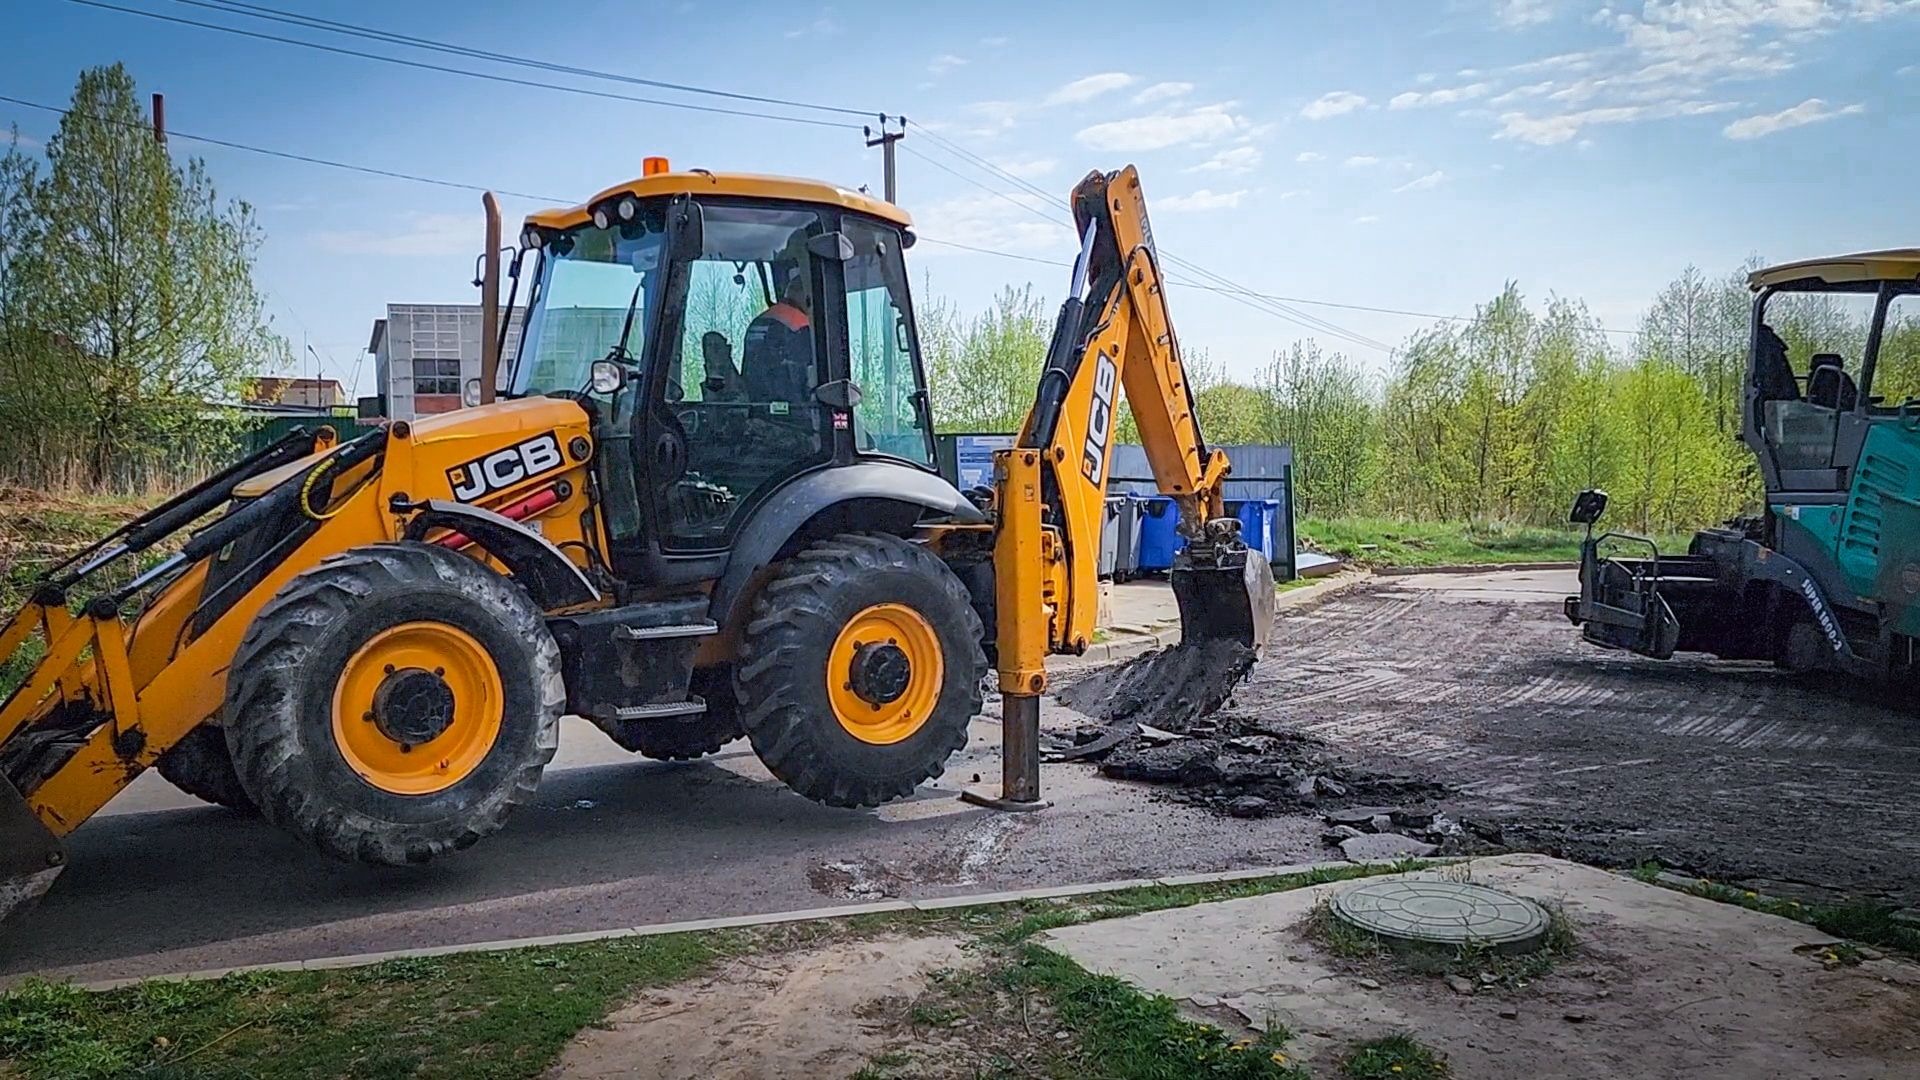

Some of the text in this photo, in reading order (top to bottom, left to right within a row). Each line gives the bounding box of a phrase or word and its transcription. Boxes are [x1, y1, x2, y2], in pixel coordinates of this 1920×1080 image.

[1085, 355, 1116, 484] JCB
[455, 436, 561, 500] JCB
[1801, 578, 1823, 614] SUPER
